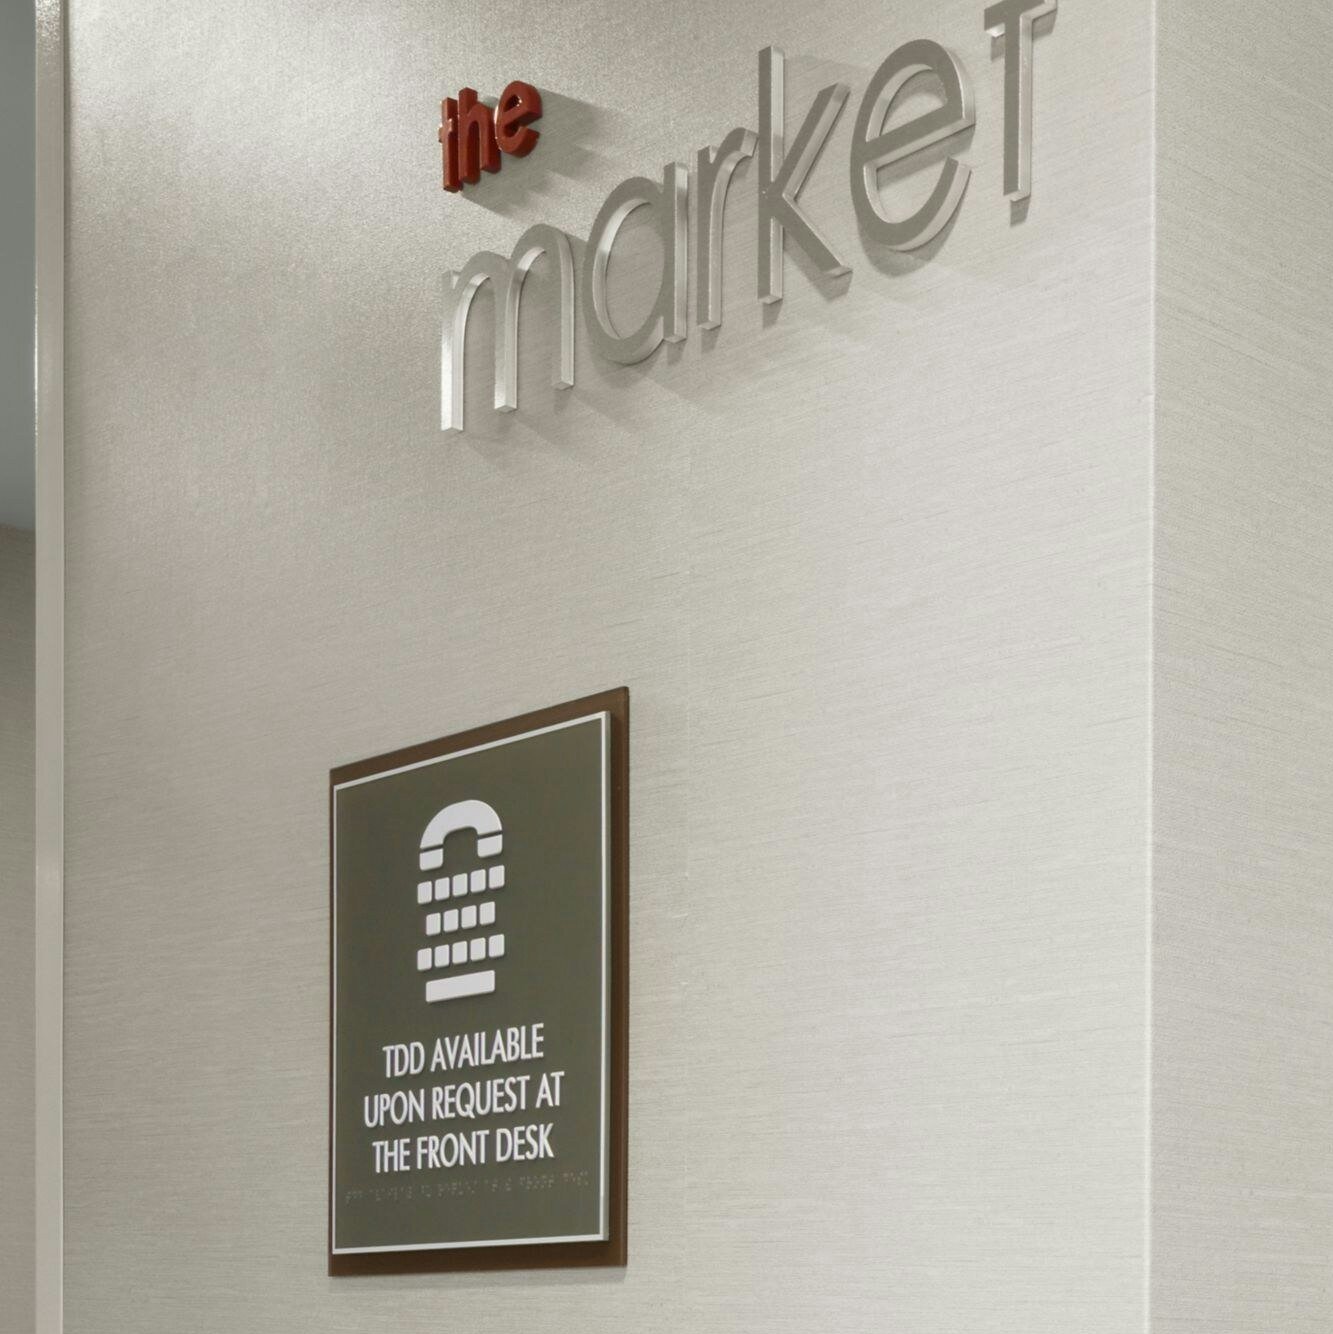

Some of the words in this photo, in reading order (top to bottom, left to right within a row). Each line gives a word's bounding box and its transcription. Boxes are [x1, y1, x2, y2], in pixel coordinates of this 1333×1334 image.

[437, 80, 543, 192] the
[440, 0, 1057, 431] market
[382, 1041, 425, 1078] TDD
[431, 1023, 545, 1073] AVAILABLE
[364, 1089, 426, 1128] UPON
[432, 1075, 531, 1120] REQUEST
[536, 1071, 566, 1107] AT
[372, 1139, 412, 1174] THE
[416, 1130, 490, 1171] FRONT
[495, 1123, 555, 1163] DESK
